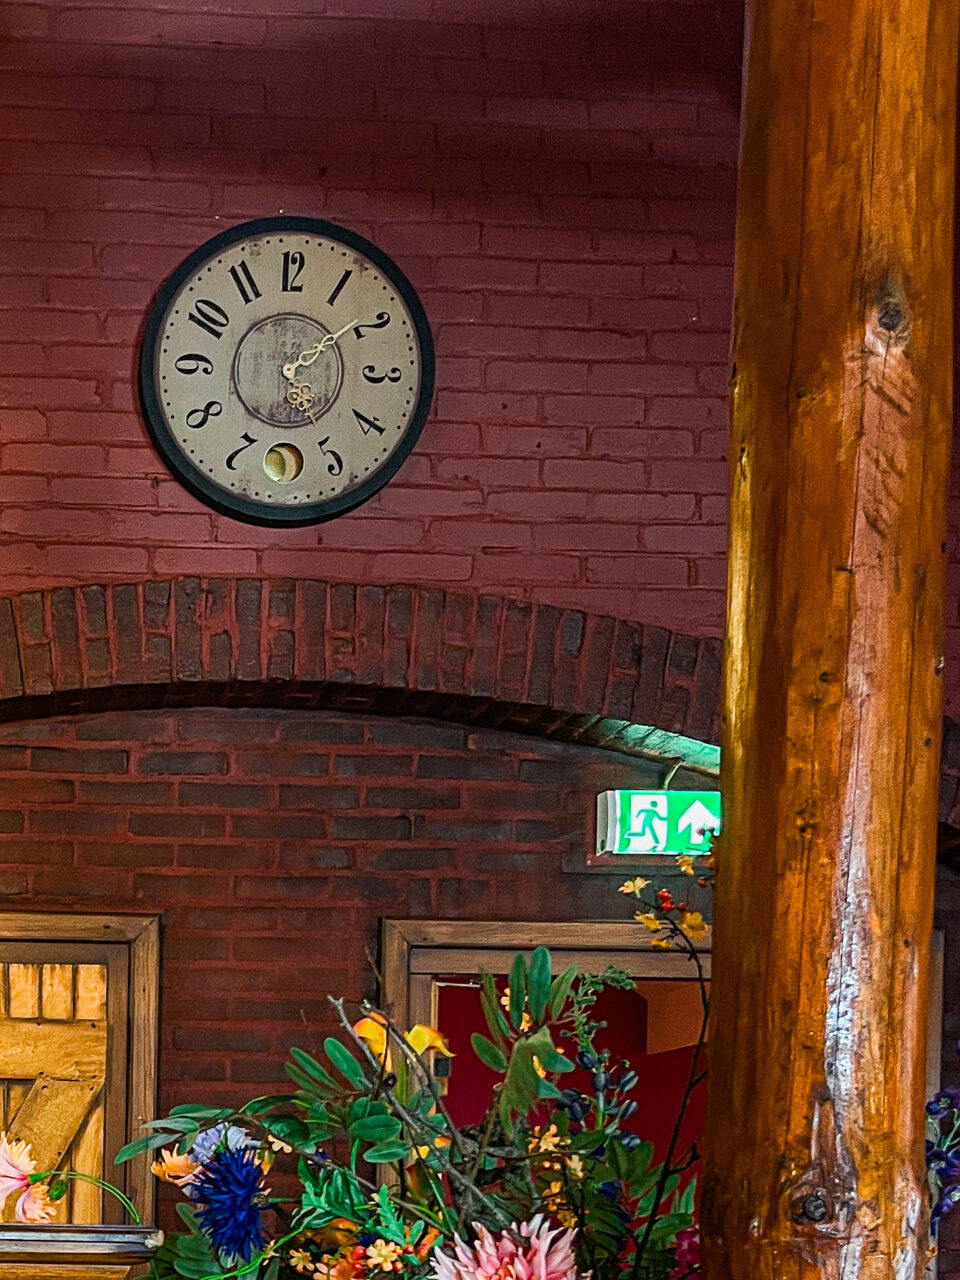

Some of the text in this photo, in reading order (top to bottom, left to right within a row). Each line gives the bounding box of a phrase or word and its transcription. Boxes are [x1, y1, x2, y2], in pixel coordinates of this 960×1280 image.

[228, 260, 262, 305] 11
[281, 251, 305, 292] 12
[327, 269, 353, 306] 1
[188, 300, 229, 340] 10
[353, 312, 390, 340] 2
[175, 354, 213, 375] 9
[363, 365, 401, 384] 3
[186, 401, 222, 428] 8
[352, 408, 386, 436] 4
[226, 432, 258, 470] 7
[318, 436, 343, 476] 5
